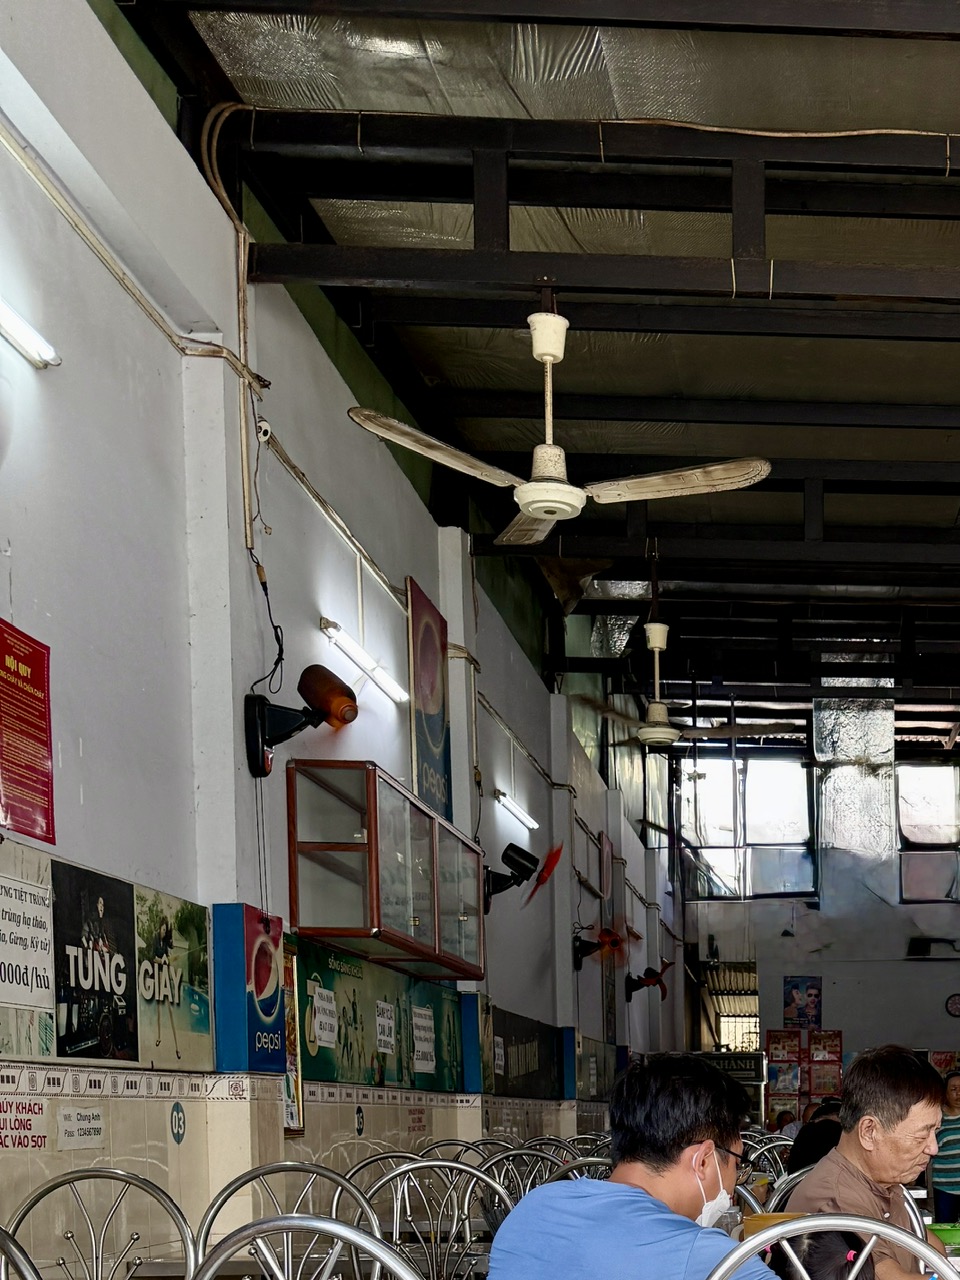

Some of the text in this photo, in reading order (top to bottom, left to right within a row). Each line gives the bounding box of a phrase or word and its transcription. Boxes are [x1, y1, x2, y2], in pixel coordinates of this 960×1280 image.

[1, 907, 21, 928] trùng
[22, 911, 31, 930] hạ
[138, 954, 183, 1005] GIÂY
[255, 1030, 282, 1053] pepsi
[15, 1099, 44, 1115] KHÁCH
[9, 1114, 32, 1131] LÒNG
[76, 1112, 91, 1124] Chung
[172, 1110, 185, 1135] 03
[10, 1131, 30, 1149] VÀO
[31, 1134, 47, 1151] SỌT
